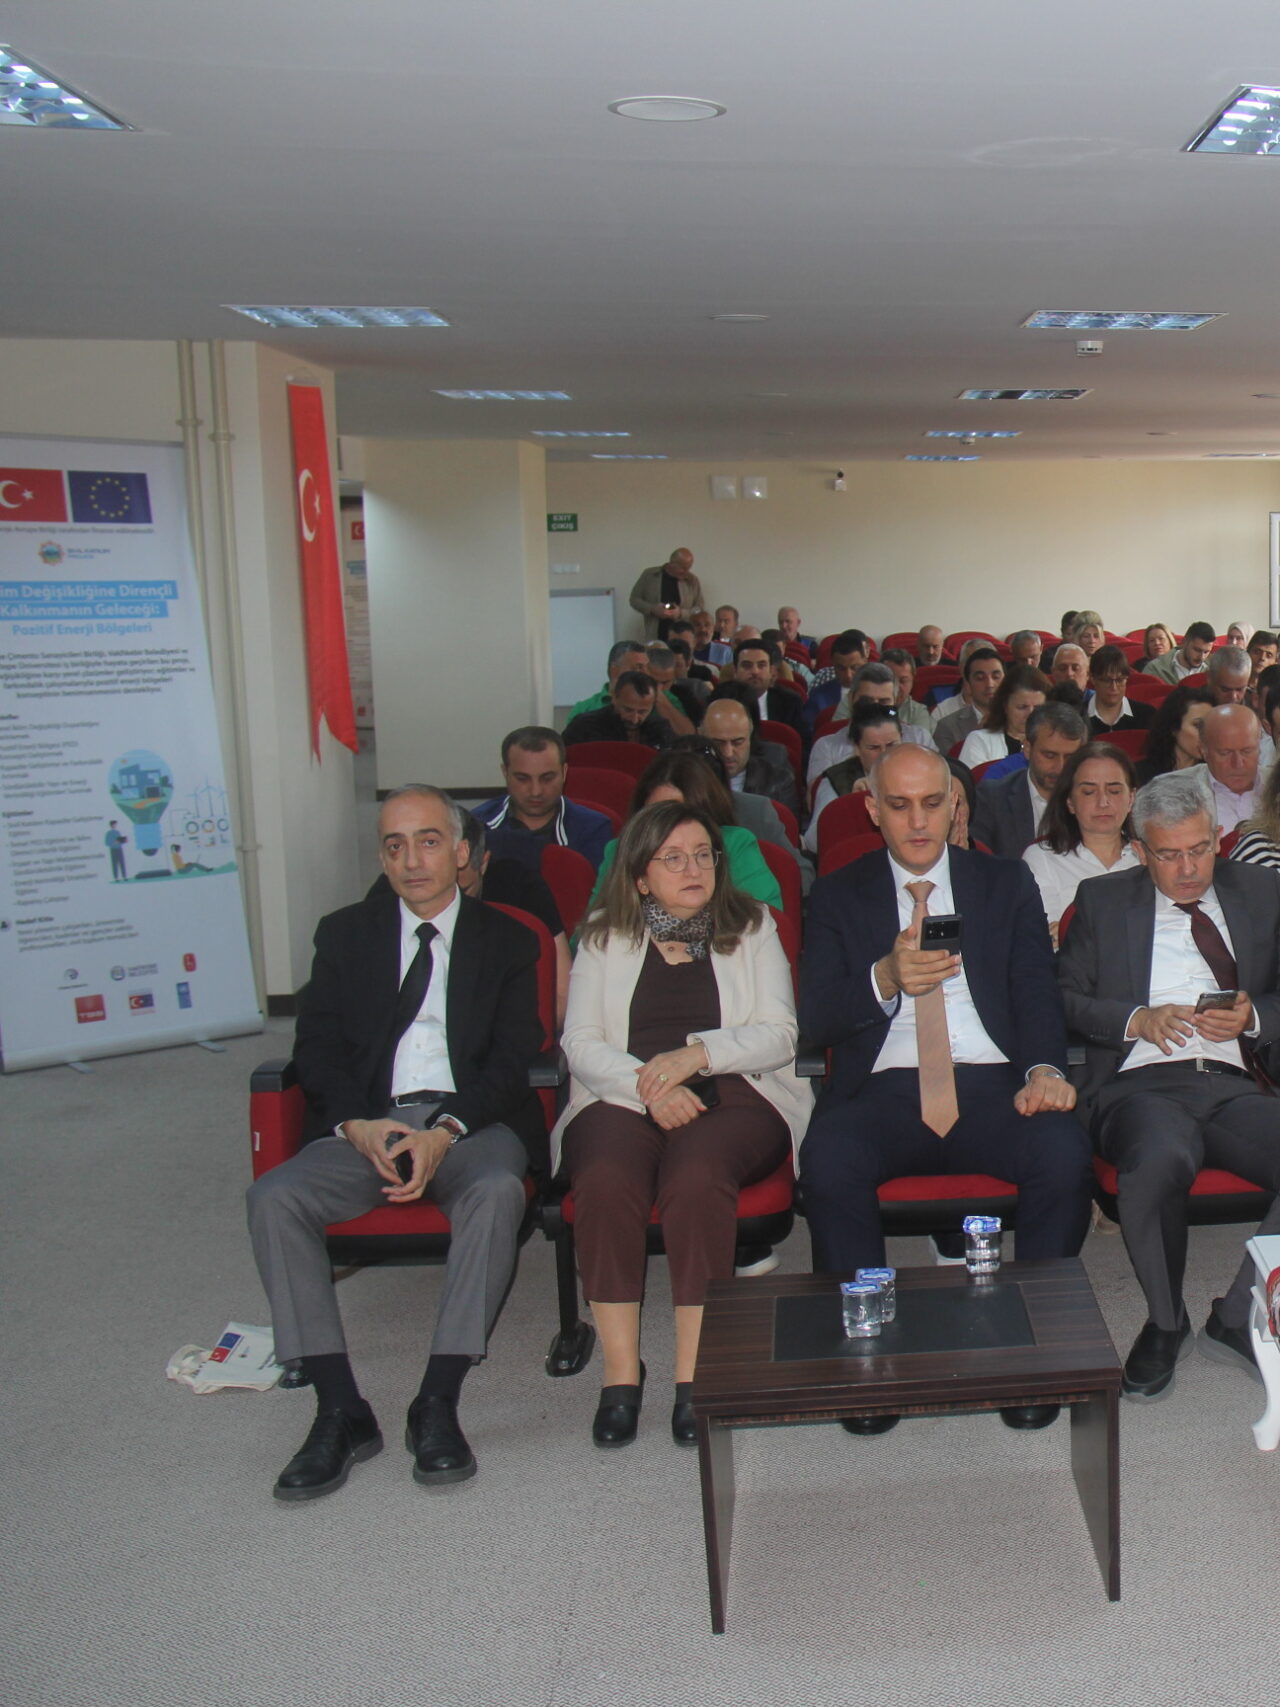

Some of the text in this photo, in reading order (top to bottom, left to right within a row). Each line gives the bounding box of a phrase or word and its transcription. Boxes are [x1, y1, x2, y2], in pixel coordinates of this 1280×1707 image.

[21, 584, 116, 600] Değişikliğine
[119, 583, 173, 599] Dirençli
[0, 602, 161, 617] Kalkınmanın Geleceği:
[12, 621, 153, 637] Pozitif Enerji Bölgeleri
